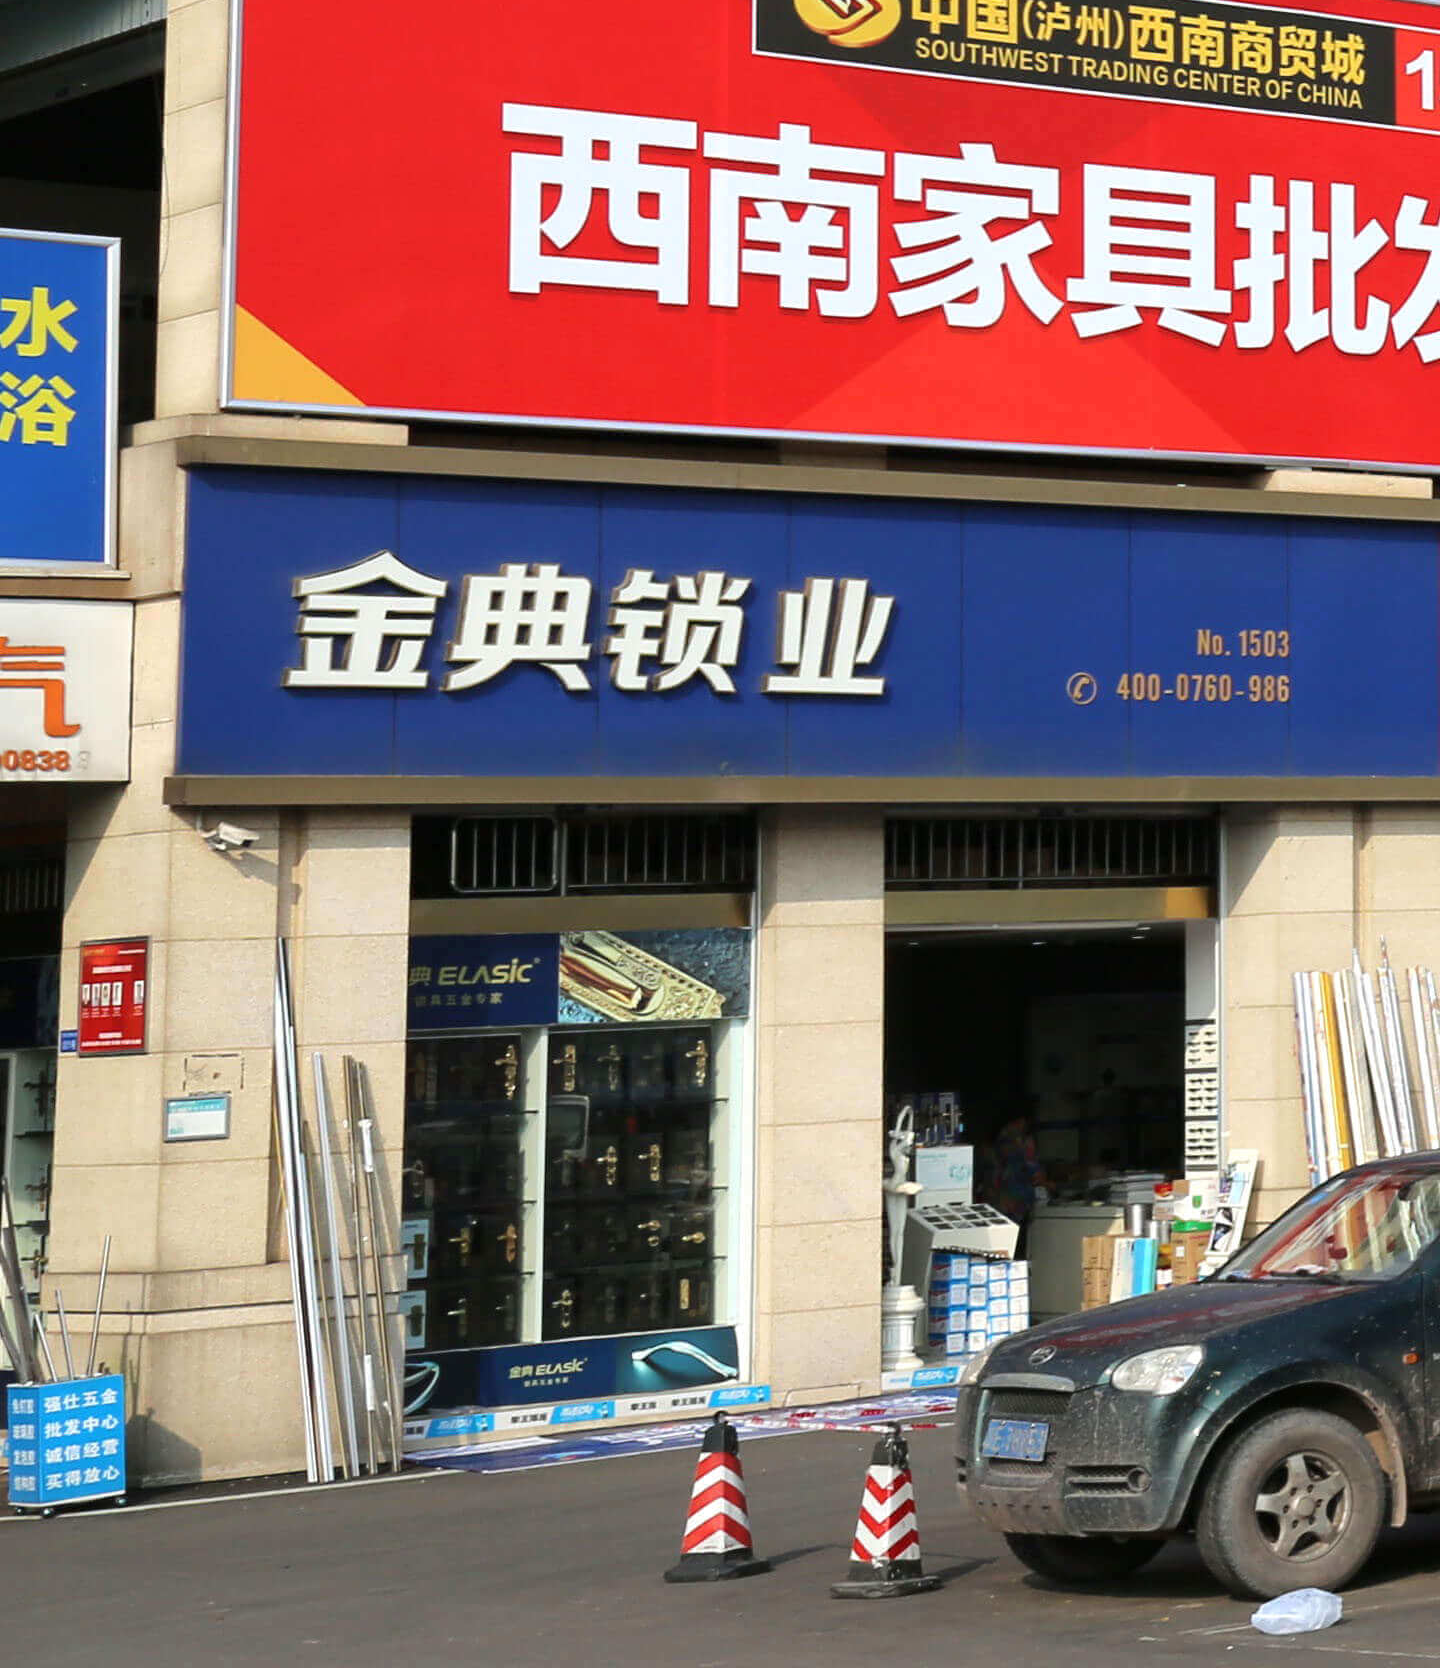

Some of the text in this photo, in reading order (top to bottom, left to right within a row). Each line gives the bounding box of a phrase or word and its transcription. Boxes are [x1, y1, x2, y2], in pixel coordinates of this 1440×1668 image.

[915, 35, 1364, 110] SOUTHWEST TRADING CENTER OF CHINA
[280, 550, 896, 695] 金典锁业
[1237, 629, 1290, 659] 1503
[1115, 673, 1291, 705] 400-0760-986
[0, 748, 70, 773] 0838
[44, 1414, 119, 1439] 批发中心
[45, 1438, 120, 1463] 诚信经营
[46, 1466, 120, 1490] 买得放心
